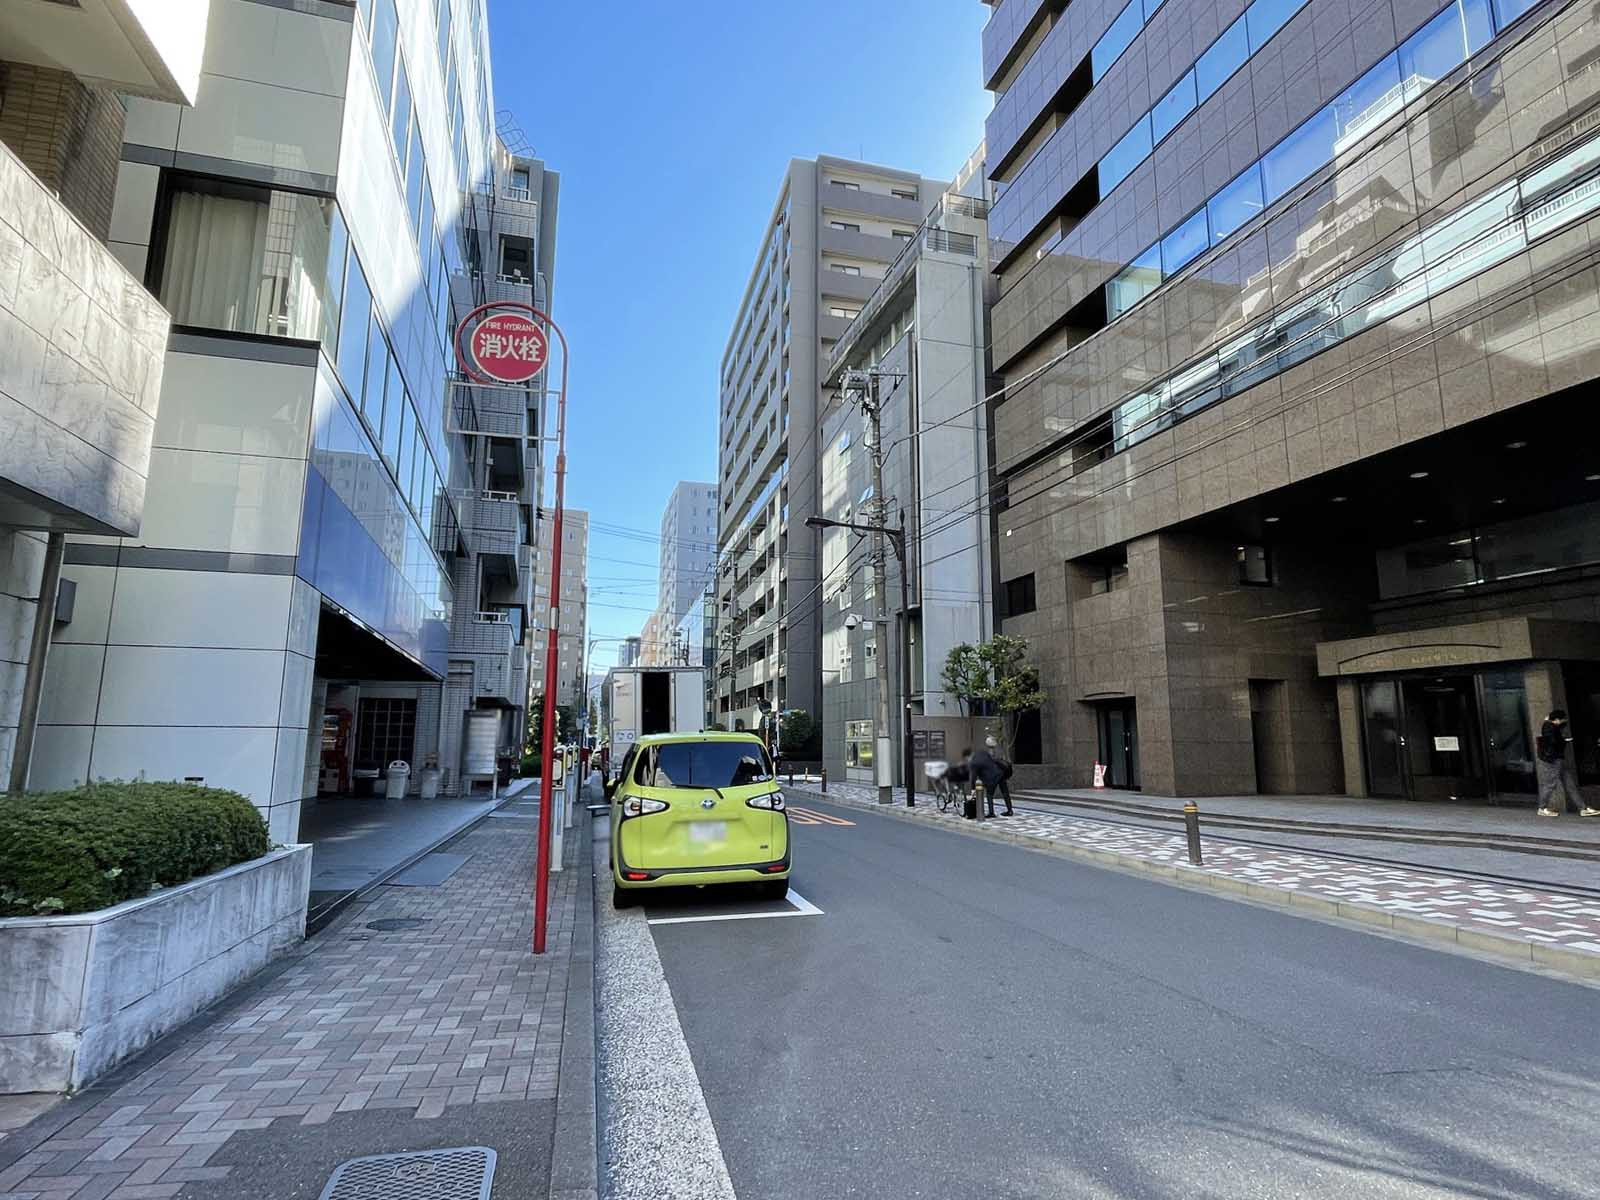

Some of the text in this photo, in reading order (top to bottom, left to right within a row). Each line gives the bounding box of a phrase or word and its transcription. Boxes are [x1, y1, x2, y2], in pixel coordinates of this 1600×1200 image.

[486, 321, 536, 332] FIRE HYDRANT
[479, 332, 542, 362] 消火栓
